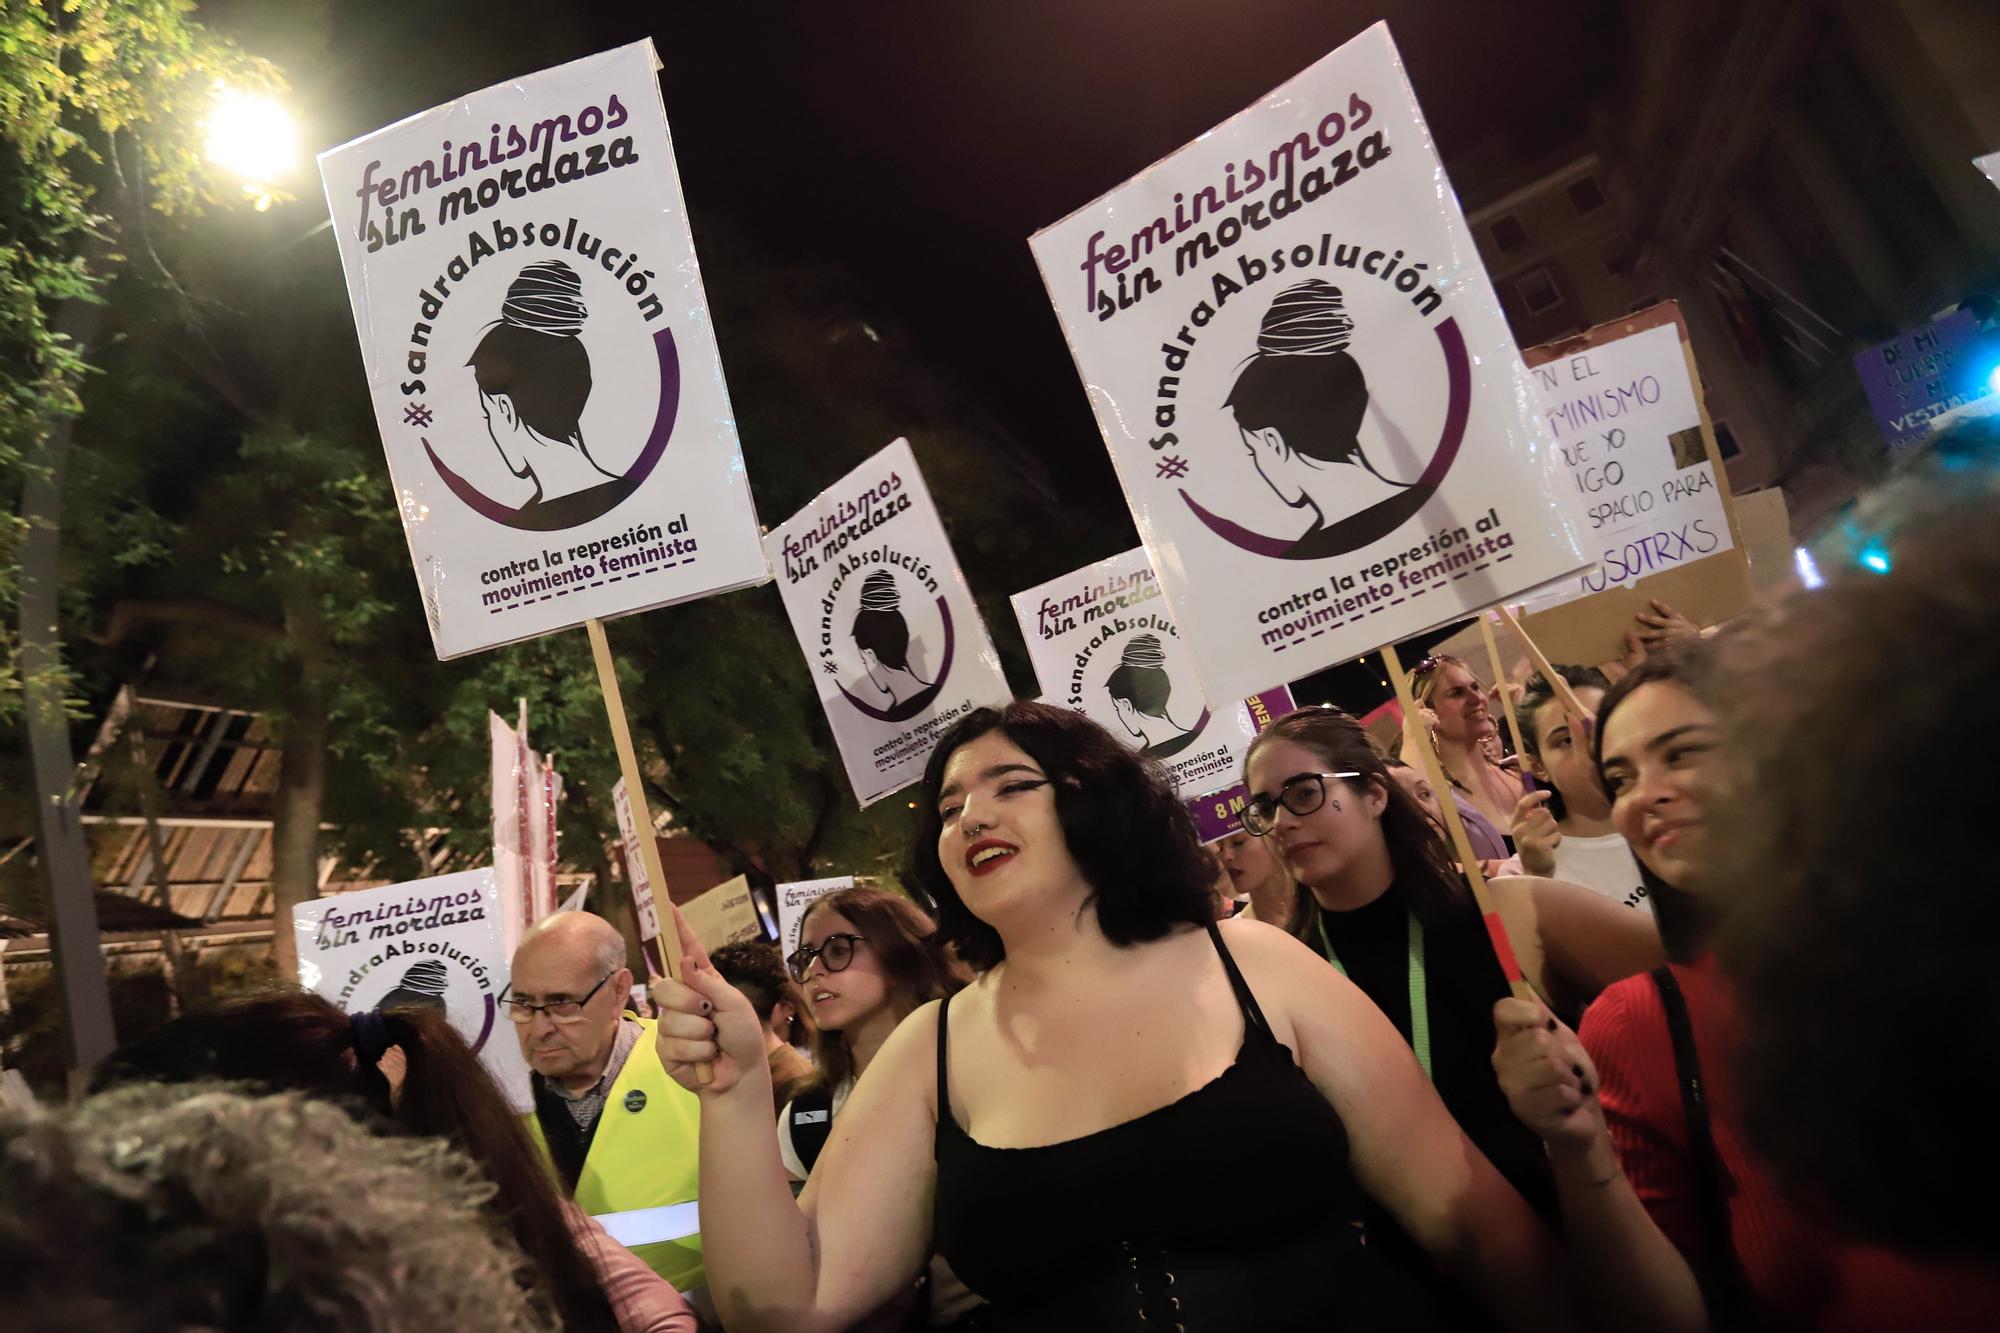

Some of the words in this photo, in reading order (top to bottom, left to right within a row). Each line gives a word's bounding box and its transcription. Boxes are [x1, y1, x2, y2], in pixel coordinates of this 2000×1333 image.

[356, 94, 629, 242] feminismos
[366, 206, 426, 254] sin
[438, 134, 639, 226] mordaza
[1080, 92, 1373, 313] feminismos
[1098, 266, 1162, 322] sin
[1175, 130, 1392, 277] mordaza
[400, 217, 665, 428] #SandraAbsolución
[1149, 233, 1443, 480] #SandraAbsolución
[1570, 356, 1600, 381] EL
[1601, 428, 1626, 452] YO
[781, 471, 902, 579] feminismos
[1588, 490, 1654, 528] SPACIO
[1662, 471, 1714, 503] PARA
[480, 556, 541, 586] contra
[543, 548, 564, 570] la
[568, 523, 663, 564] represión
[667, 513, 689, 538] al
[482, 563, 596, 607] movimiento
[599, 536, 698, 573] feminista
[791, 553, 819, 584] sin
[823, 492, 912, 563] mordaza
[1257, 587, 1329, 626] contra
[1331, 574, 1355, 596] la
[1360, 526, 1467, 584] represión
[1474, 508, 1502, 540] al
[1037, 568, 1156, 635] feminism
[1044, 615, 1077, 640] sin
[1083, 581, 1163, 625] morda
[1261, 580, 1394, 647] movimiento
[1399, 531, 1514, 591] feminista
[873, 735, 904, 757] contra
[913, 707, 960, 737] represión
[961, 699, 974, 713] al
[874, 737, 928, 769] movimiento
[1217, 744, 1229, 756] al
[1183, 756, 1234, 779] feminista
[1214, 802, 1228, 820] 8
[316, 888, 482, 945] feminismos
[319, 927, 361, 952] sin
[369, 906, 486, 940] mordaza
